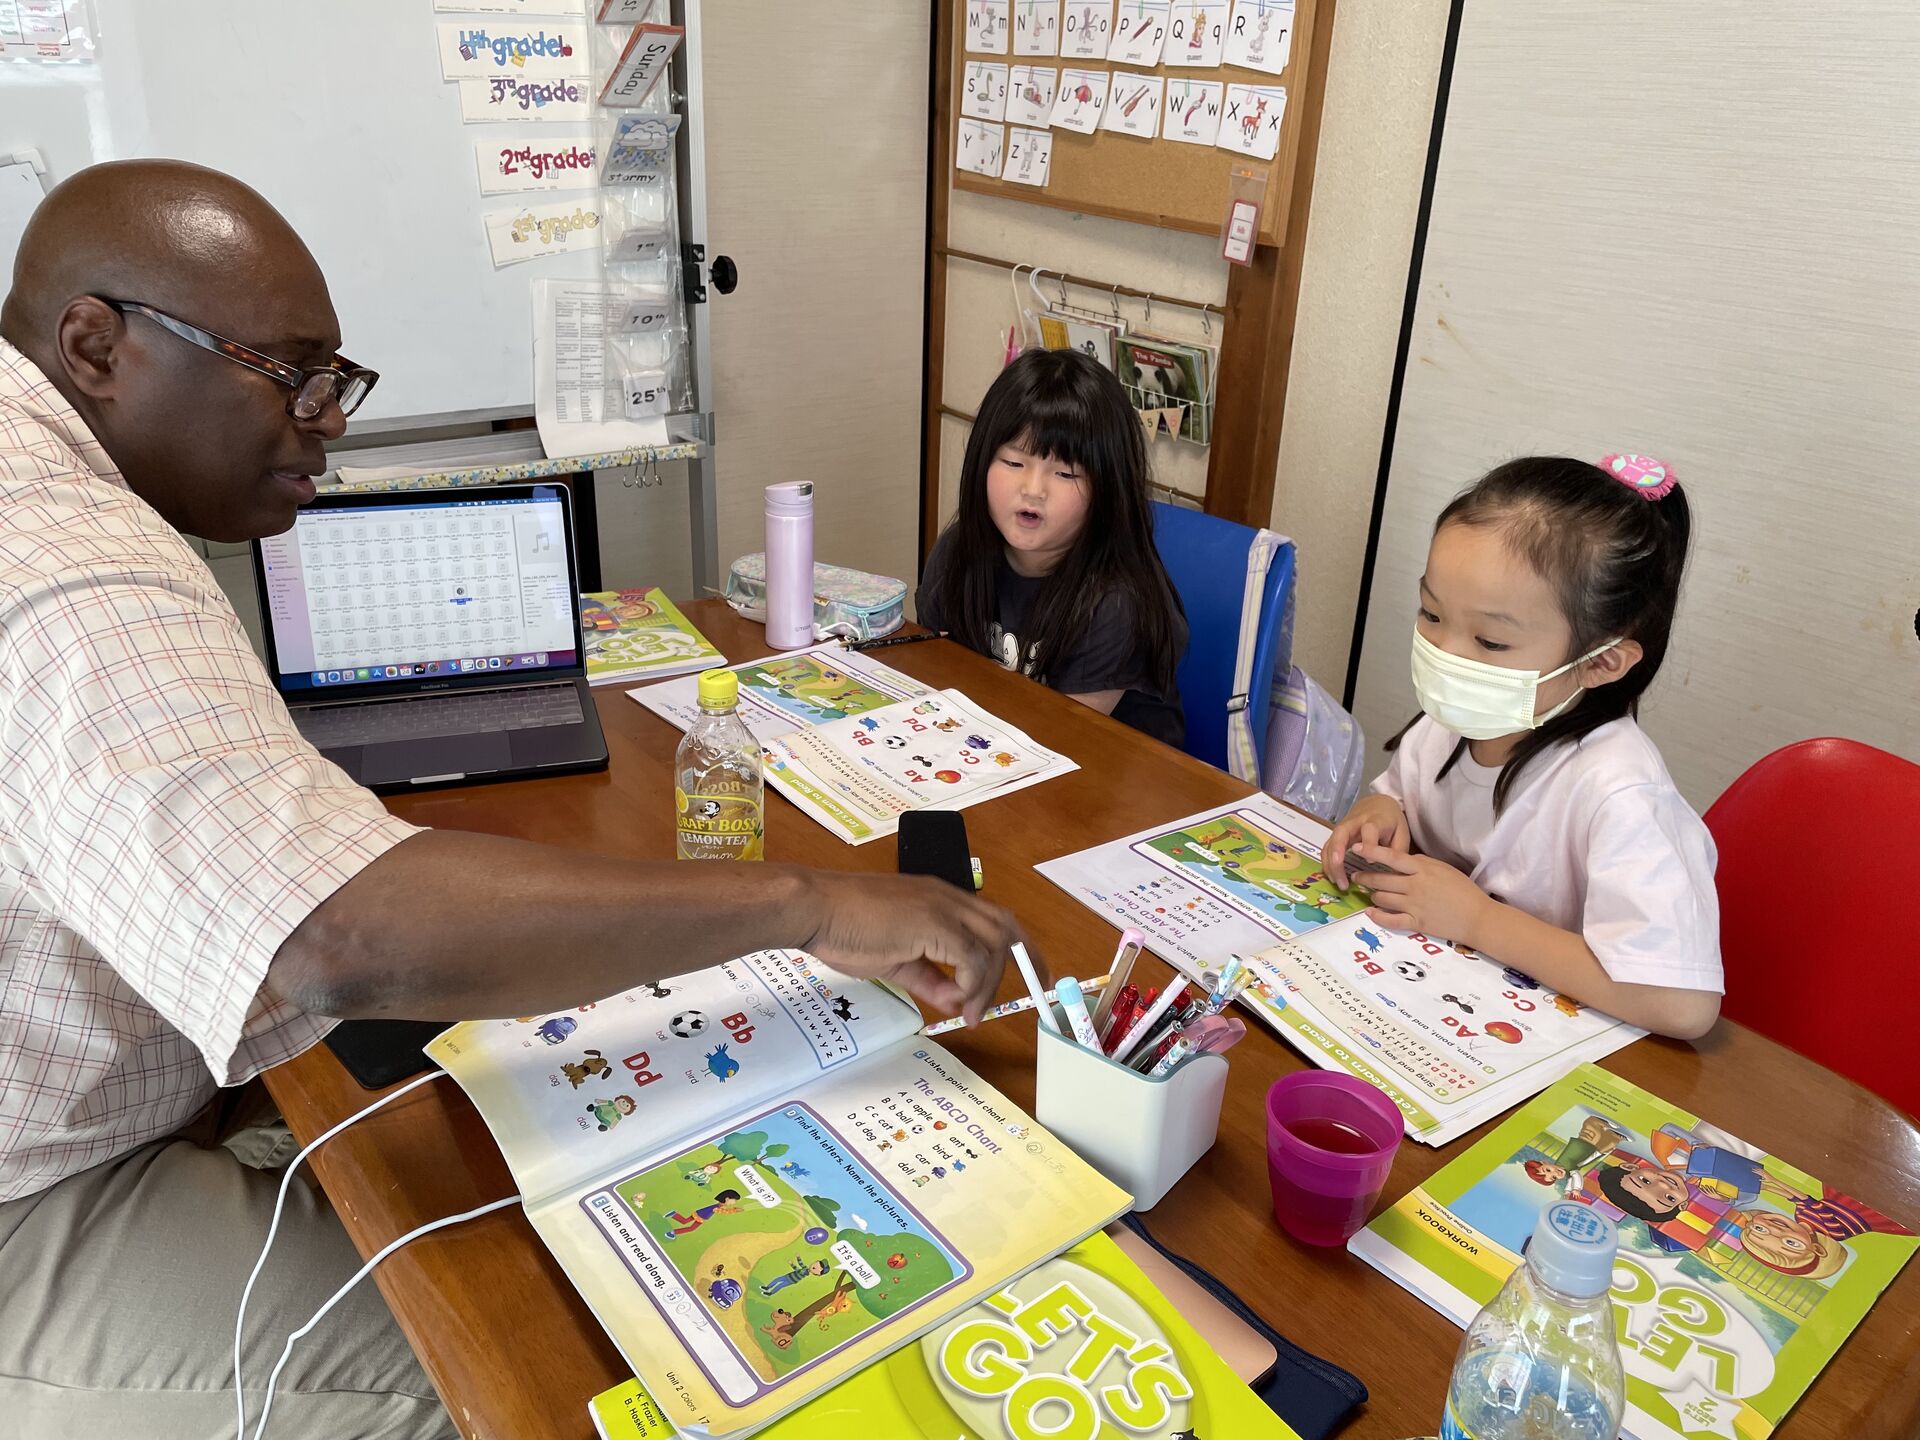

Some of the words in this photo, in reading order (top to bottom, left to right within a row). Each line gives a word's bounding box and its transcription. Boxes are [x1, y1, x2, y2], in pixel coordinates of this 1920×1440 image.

[969, 12, 980, 28] M
[1017, 14, 1026, 31] N
[1066, 15, 1076, 33] O
[1118, 17, 1129, 36] P
[1234, 15, 1246, 36] R
[1172, 19, 1184, 40] Q
[491, 31, 561, 67] grade
[615, 43, 667, 97] Sunday
[967, 77, 976, 93] S
[1014, 83, 1022, 98] T
[516, 79, 579, 110] grade
[1061, 87, 1072, 103] U
[1114, 87, 1123, 104] V
[1170, 96, 1184, 113] W
[1227, 101, 1241, 121] X
[963, 133, 972, 149] Y
[1011, 145, 1020, 159] Z
[500, 146, 532, 175] 2nd
[530, 147, 592, 179] grade
[608, 172, 657, 184] stormy
[539, 208, 597, 245] grade
[631, 313, 666, 325] 10th
[631, 386, 667, 405] 25th
[902, 718, 928, 733] Dd
[851, 730, 876, 746] Bb
[958, 750, 981, 766] Cc
[904, 770, 929, 783] Aa
[790, 777, 813, 794] Read
[822, 799, 843, 815] Learn
[718, 817, 757, 831] BOSS
[840, 814, 860, 828] Let's
[680, 832, 723, 845] LEMON
[725, 836, 747, 845] TEA
[1113, 892, 1139, 909] Chant
[1139, 910, 1169, 927] ABCD
[1169, 926, 1186, 939] The
[1408, 932, 1444, 956] Dd
[1353, 950, 1385, 976] Bb
[791, 956, 833, 998] Phonics
[1502, 990, 1537, 1012] Cc
[721, 1011, 756, 1044] Bb
[1413, 1018, 1430, 1030] and
[1441, 1016, 1480, 1038] Aa
[1299, 1024, 1334, 1049] Read
[1432, 1030, 1455, 1047] point,
[1334, 1048, 1350, 1060] to
[1457, 1047, 1483, 1066] Listen,
[622, 1051, 663, 1087] Dd
[1398, 1060, 1415, 1073] and
[549, 1074, 560, 1087] dog
[685, 1068, 699, 1085] bird
[1350, 1061, 1388, 1090] Learn
[1416, 1073, 1436, 1088] Sing
[924, 1057, 947, 1077] Listen,
[946, 1077, 966, 1095] point,
[968, 1093, 984, 1106] and
[982, 1105, 1005, 1125] chant.
[1387, 1089, 1418, 1116] Let's
[896, 1111, 913, 1125] ball
[913, 1104, 934, 1121] apple
[913, 1077, 935, 1097] The
[932, 1096, 969, 1124] ABCD
[966, 1123, 1004, 1154] Chant
[576, 1116, 590, 1131] doll
[878, 1119, 893, 1131] cat
[862, 1128, 877, 1141] dog
[950, 1136, 966, 1148] ant
[915, 1152, 931, 1166] car
[932, 1144, 952, 1160] bird
[794, 1117, 811, 1130] Find
[808, 1128, 821, 1141] the
[820, 1140, 843, 1165] letters.
[844, 1164, 865, 1185] Name
[864, 1184, 878, 1198] the
[874, 1198, 908, 1230] pictures.
[898, 1161, 916, 1176] doll
[741, 1168, 759, 1187] What
[757, 1186, 765, 1195] is
[762, 1193, 775, 1203] it?
[1430, 1201, 1452, 1220] Practice
[1416, 1209, 1478, 1255] WORKBOOK
[1454, 1220, 1472, 1234] Online
[601, 1205, 622, 1228] Listen
[619, 1228, 635, 1244] and
[630, 1243, 651, 1263] read
[645, 1261, 666, 1290] along.
[837, 1244, 852, 1262] It's
[854, 1264, 873, 1282] ball.
[940, 1318, 1102, 1440] GO
[666, 1371, 680, 1386] Unit
[680, 1392, 696, 1412] Colors
[636, 1392, 645, 1402] K.
[641, 1401, 658, 1428] Frazier
[1699, 1397, 1719, 1412] 2
[624, 1398, 632, 1408] B.
[628, 1407, 648, 1438] Hoskins
[698, 1415, 710, 1425] 17
